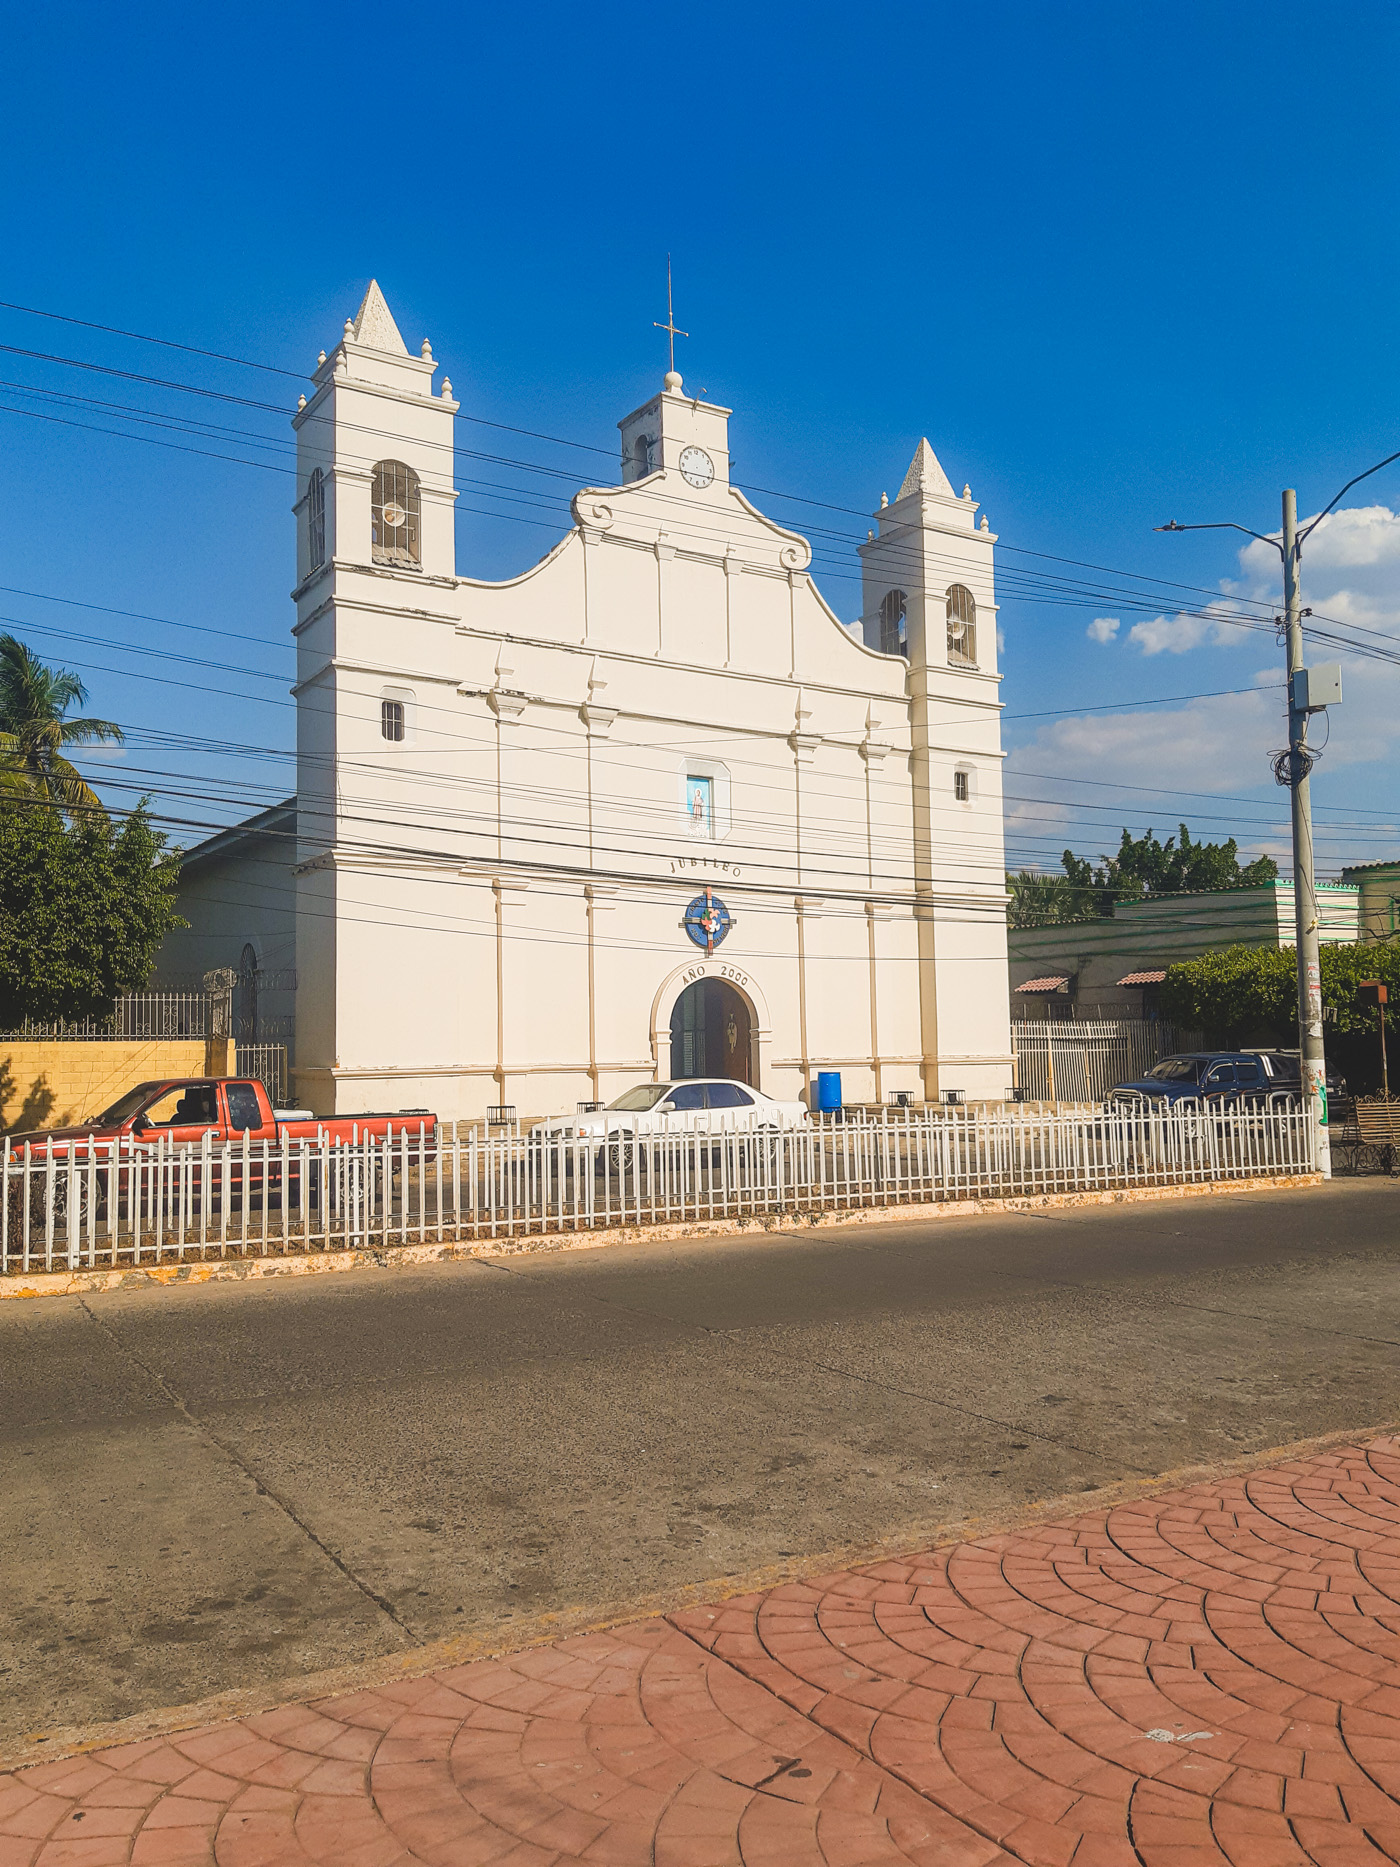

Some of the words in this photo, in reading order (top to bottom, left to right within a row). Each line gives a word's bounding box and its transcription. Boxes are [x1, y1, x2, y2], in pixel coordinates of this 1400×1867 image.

[670, 857, 741, 877] JUBILEO
[682, 966, 705, 985] AÑO
[721, 966, 747, 985] 2000
